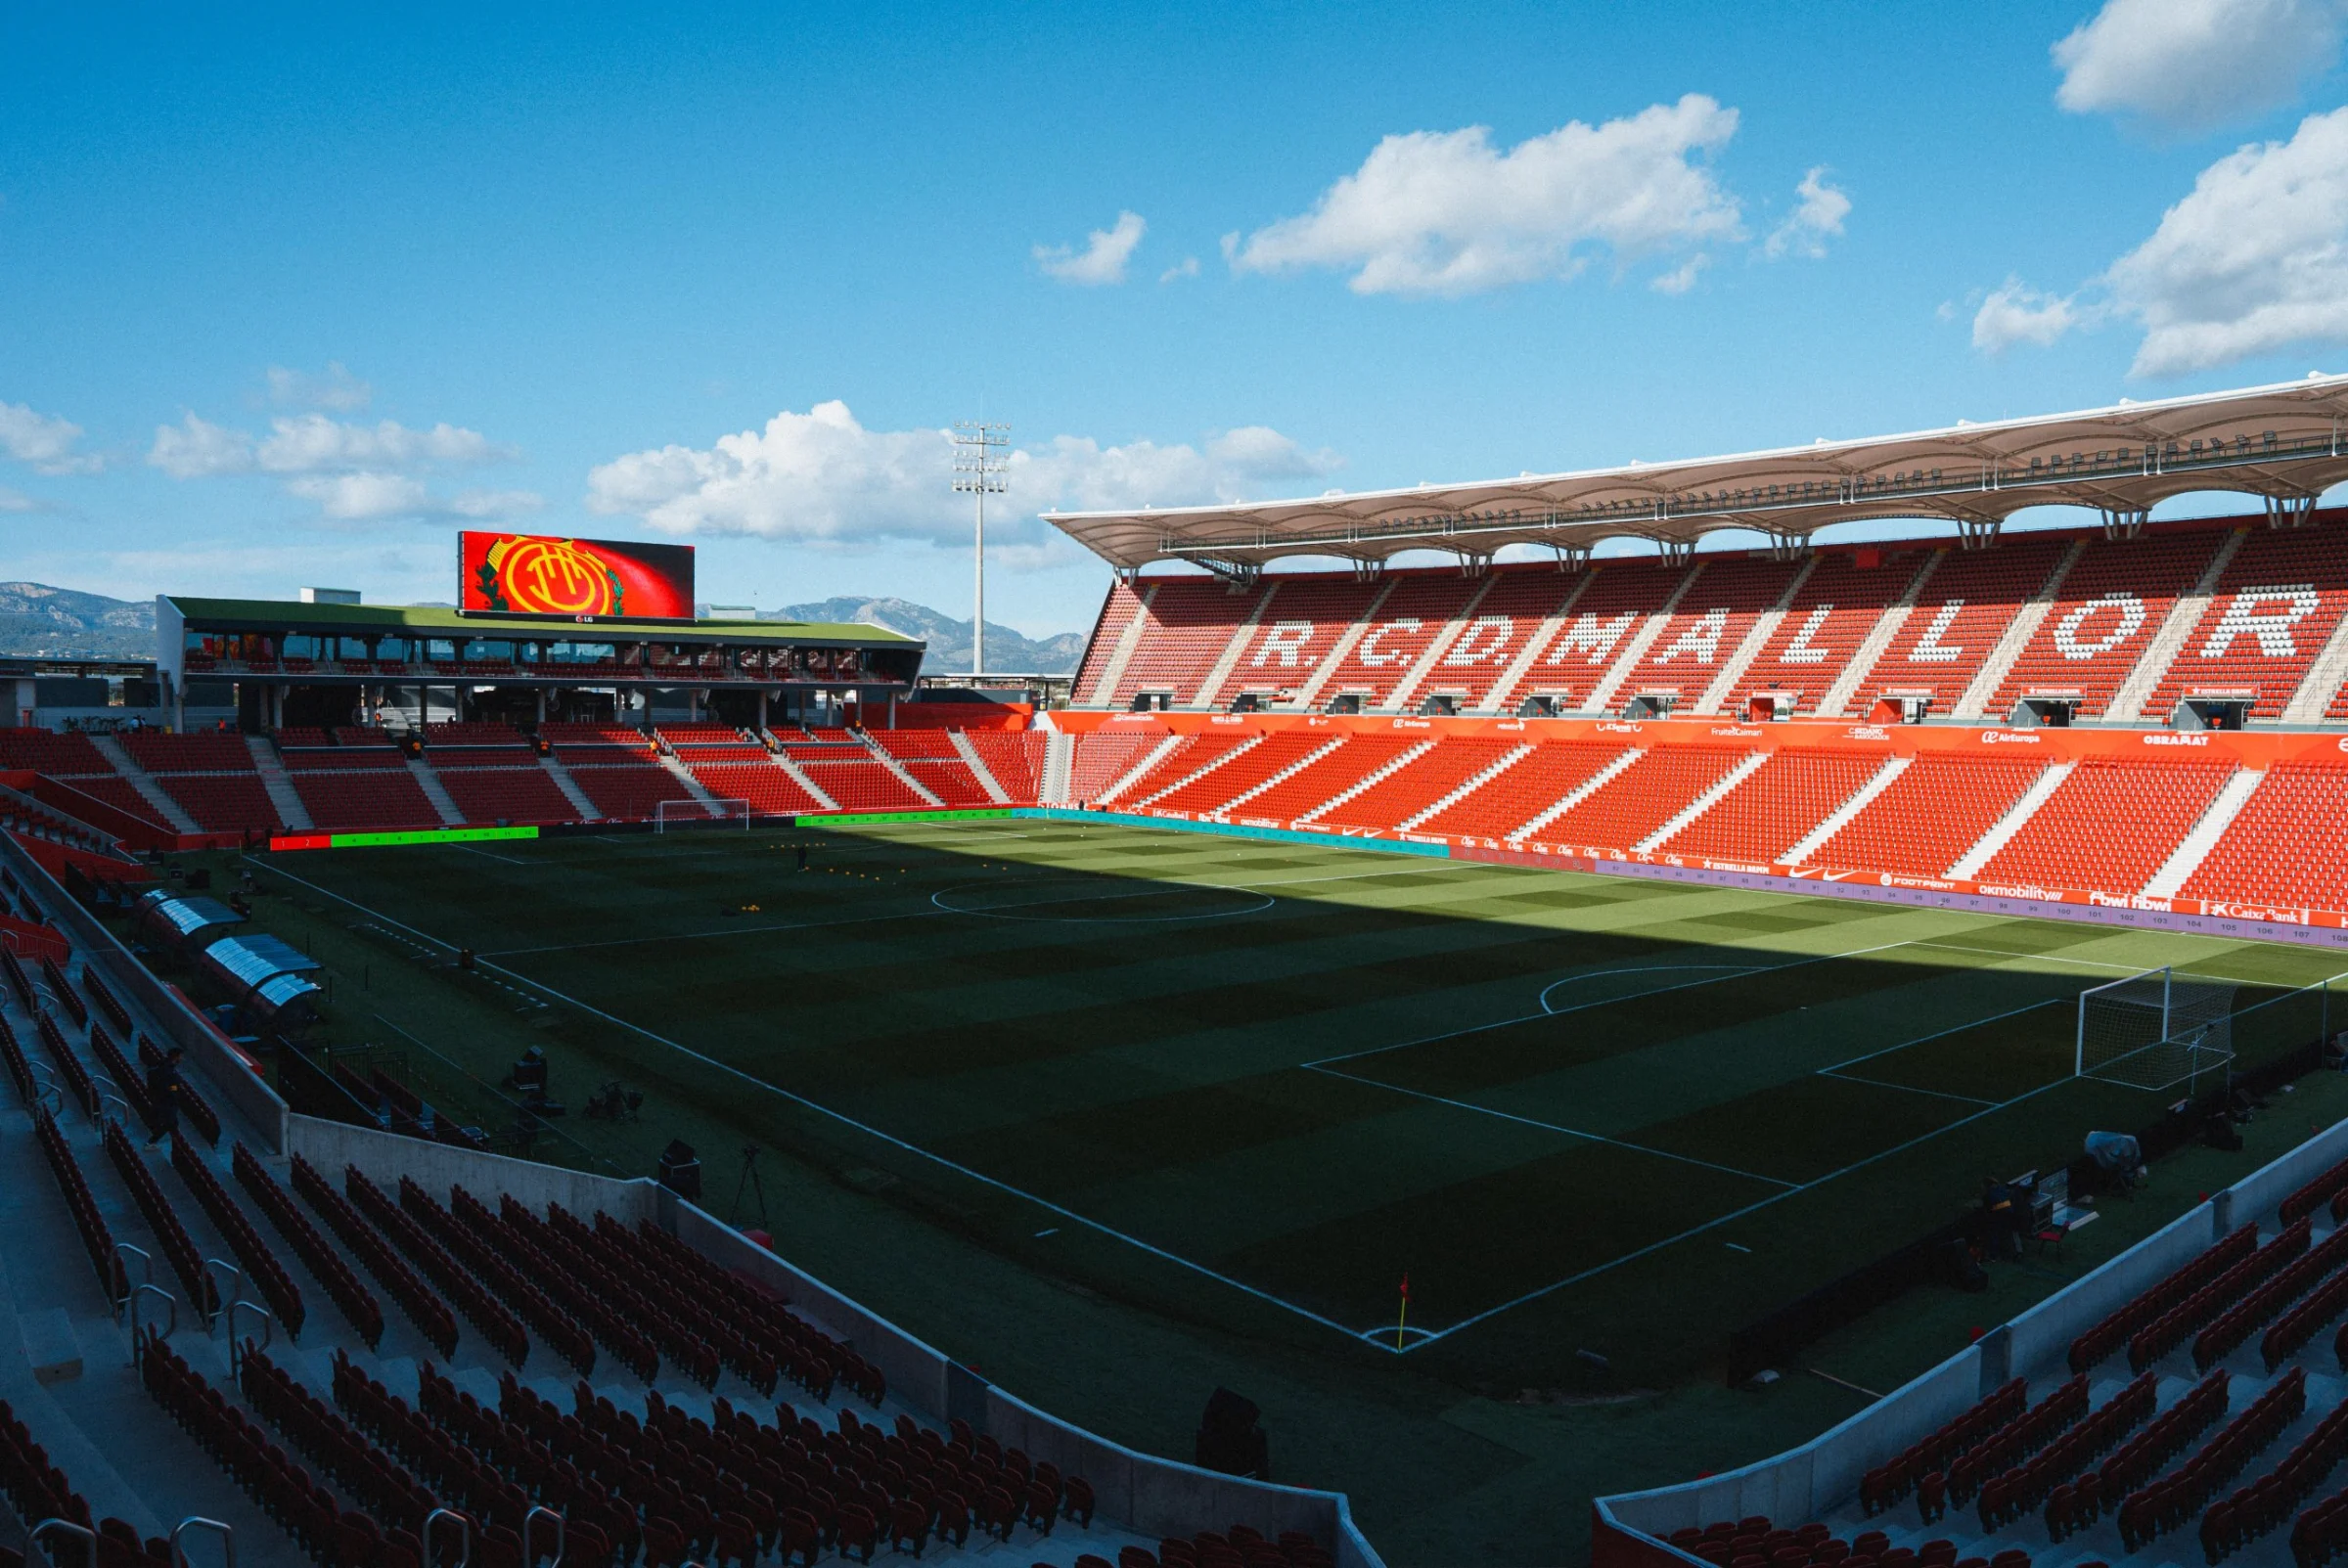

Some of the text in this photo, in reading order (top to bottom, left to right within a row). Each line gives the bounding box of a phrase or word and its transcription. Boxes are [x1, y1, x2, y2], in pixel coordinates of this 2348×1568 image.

[1999, 734, 2040, 743] AirEuropa
[2144, 735, 2209, 746] OBRAMAT
[1713, 863, 1769, 874] ESTRELLA DAMM
[1894, 877, 1955, 889] FOOTPRINT
